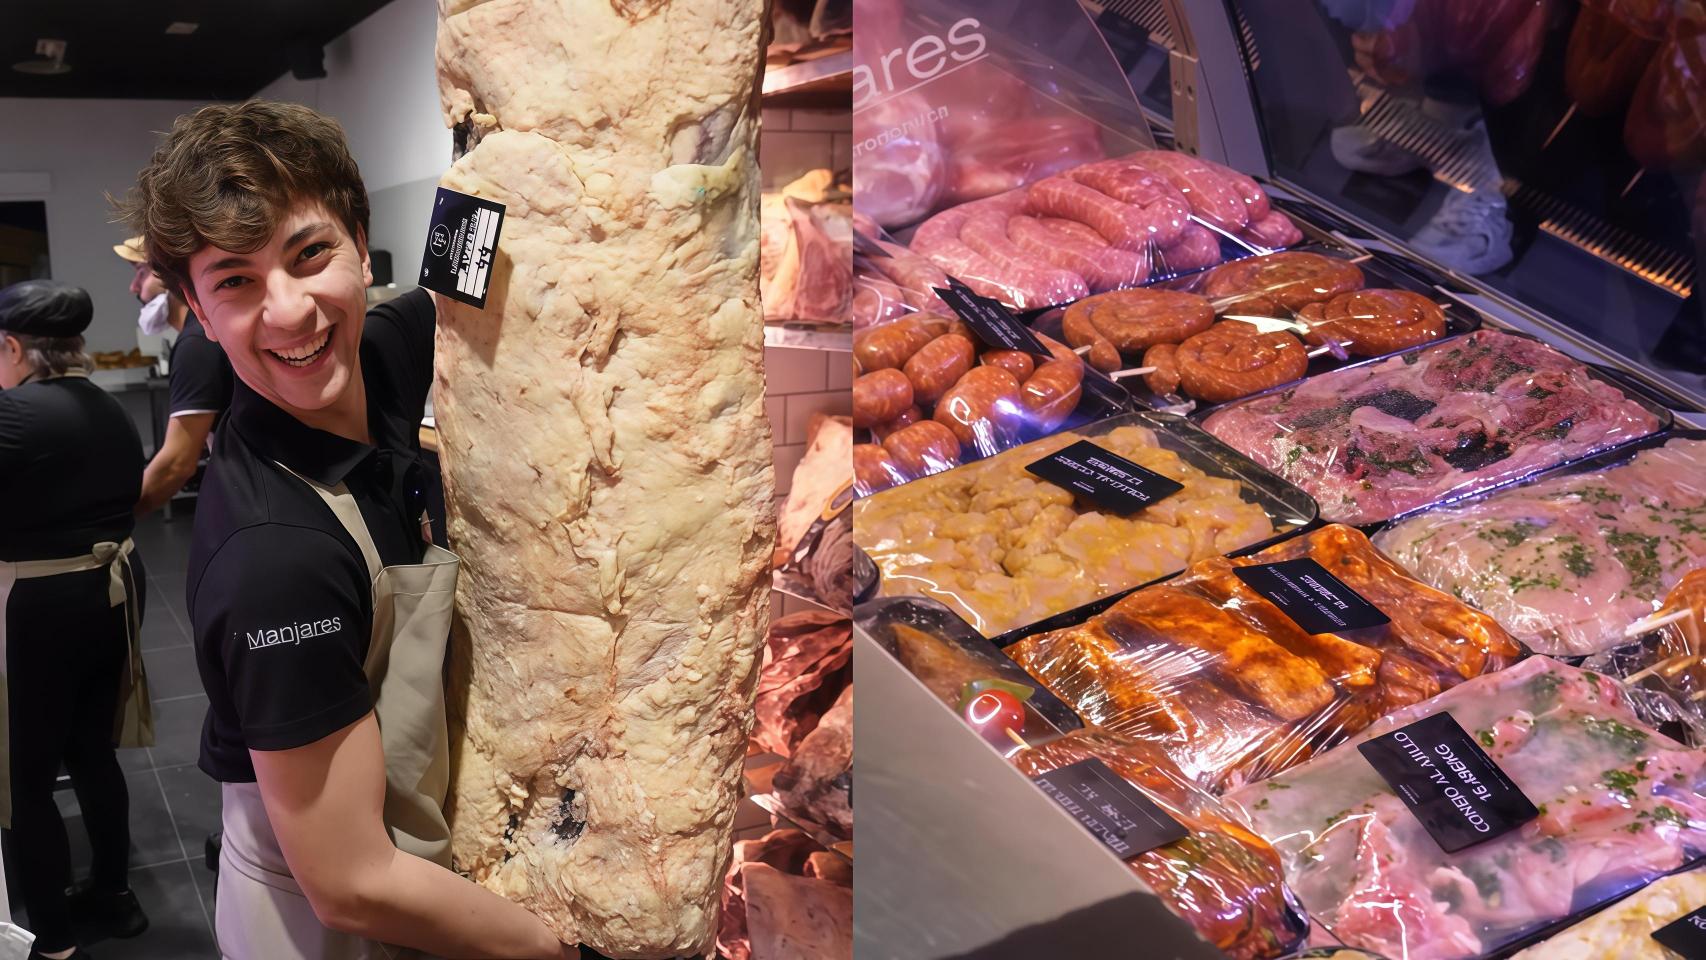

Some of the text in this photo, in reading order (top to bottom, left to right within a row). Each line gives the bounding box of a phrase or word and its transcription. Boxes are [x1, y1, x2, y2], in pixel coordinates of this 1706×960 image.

[247, 616, 342, 649] Manjares
[1429, 768, 1450, 785] AL
[1444, 786, 1490, 833] CONEJO
